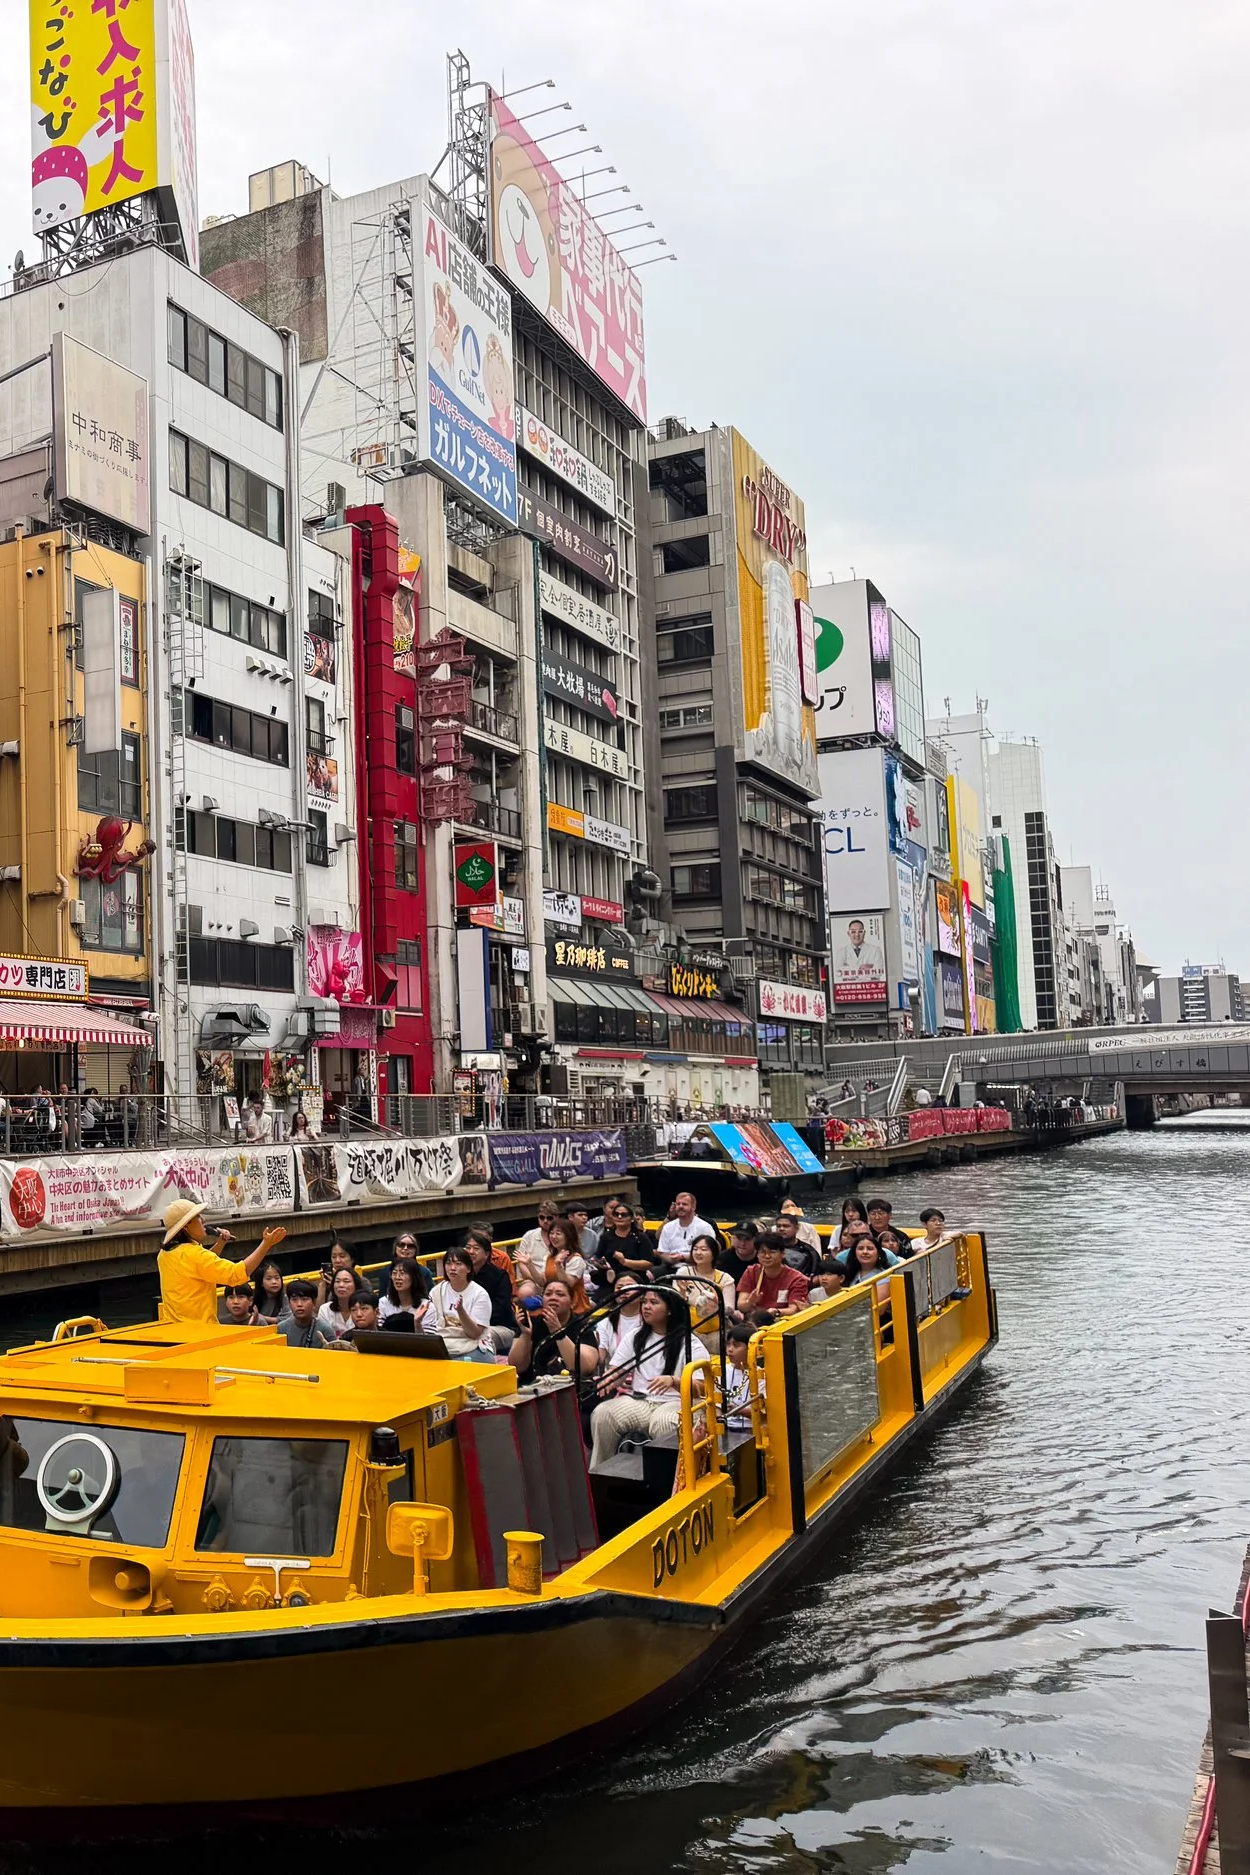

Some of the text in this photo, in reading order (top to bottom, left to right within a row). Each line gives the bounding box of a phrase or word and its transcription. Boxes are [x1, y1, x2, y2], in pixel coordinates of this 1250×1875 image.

[38, 0, 78, 139] ごなび
[425, 215, 510, 337] AI店舗の王様
[72, 411, 142, 462] 中和商事
[435, 418, 512, 510] ガルフネット
[762, 465, 790, 510] SUPER
[517, 494, 532, 521] 7F
[557, 666, 585, 699] 大牧場
[591, 740, 620, 774] 白木屋
[555, 940, 606, 972] 星乃珈琲店
[1135, 1058, 1207, 1069] えびす橋
[17, 1176, 39, 1201] 大阪
[18, 1199, 44, 1220] 中心
[60, 1200, 76, 1212] Heart
[78, 1200, 85, 1211] of
[65, 1212, 75, 1223] and
[651, 1499, 714, 1588] DOTON
